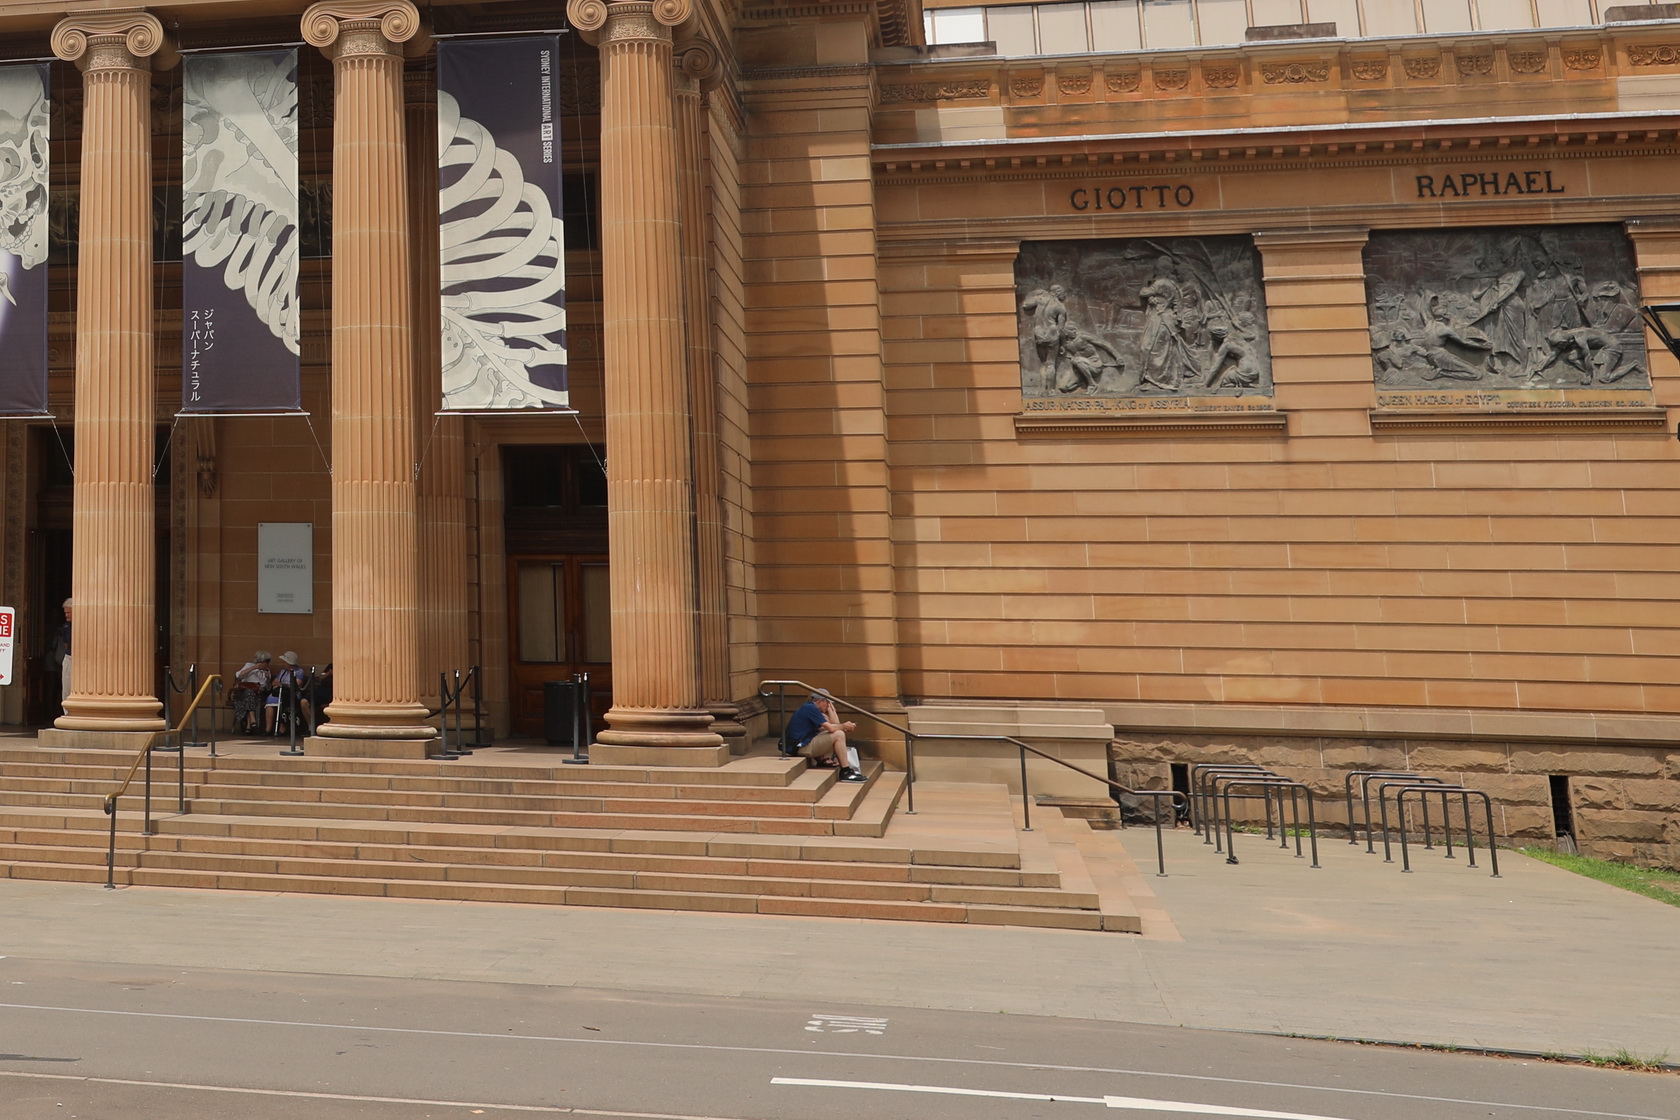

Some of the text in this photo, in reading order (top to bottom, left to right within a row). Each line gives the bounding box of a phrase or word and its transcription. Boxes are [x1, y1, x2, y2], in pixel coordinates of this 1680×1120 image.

[540, 50, 553, 163] SYDNEY INTERNATIONAL ART SERIES
[1070, 184, 1194, 210] GIOTTO
[1416, 171, 1566, 198] RAPHAEL
[204, 308, 215, 351] ジャパン
[190, 310, 201, 401] スーパーナチュラル
[1378, 395, 1412, 406] QUEEN
